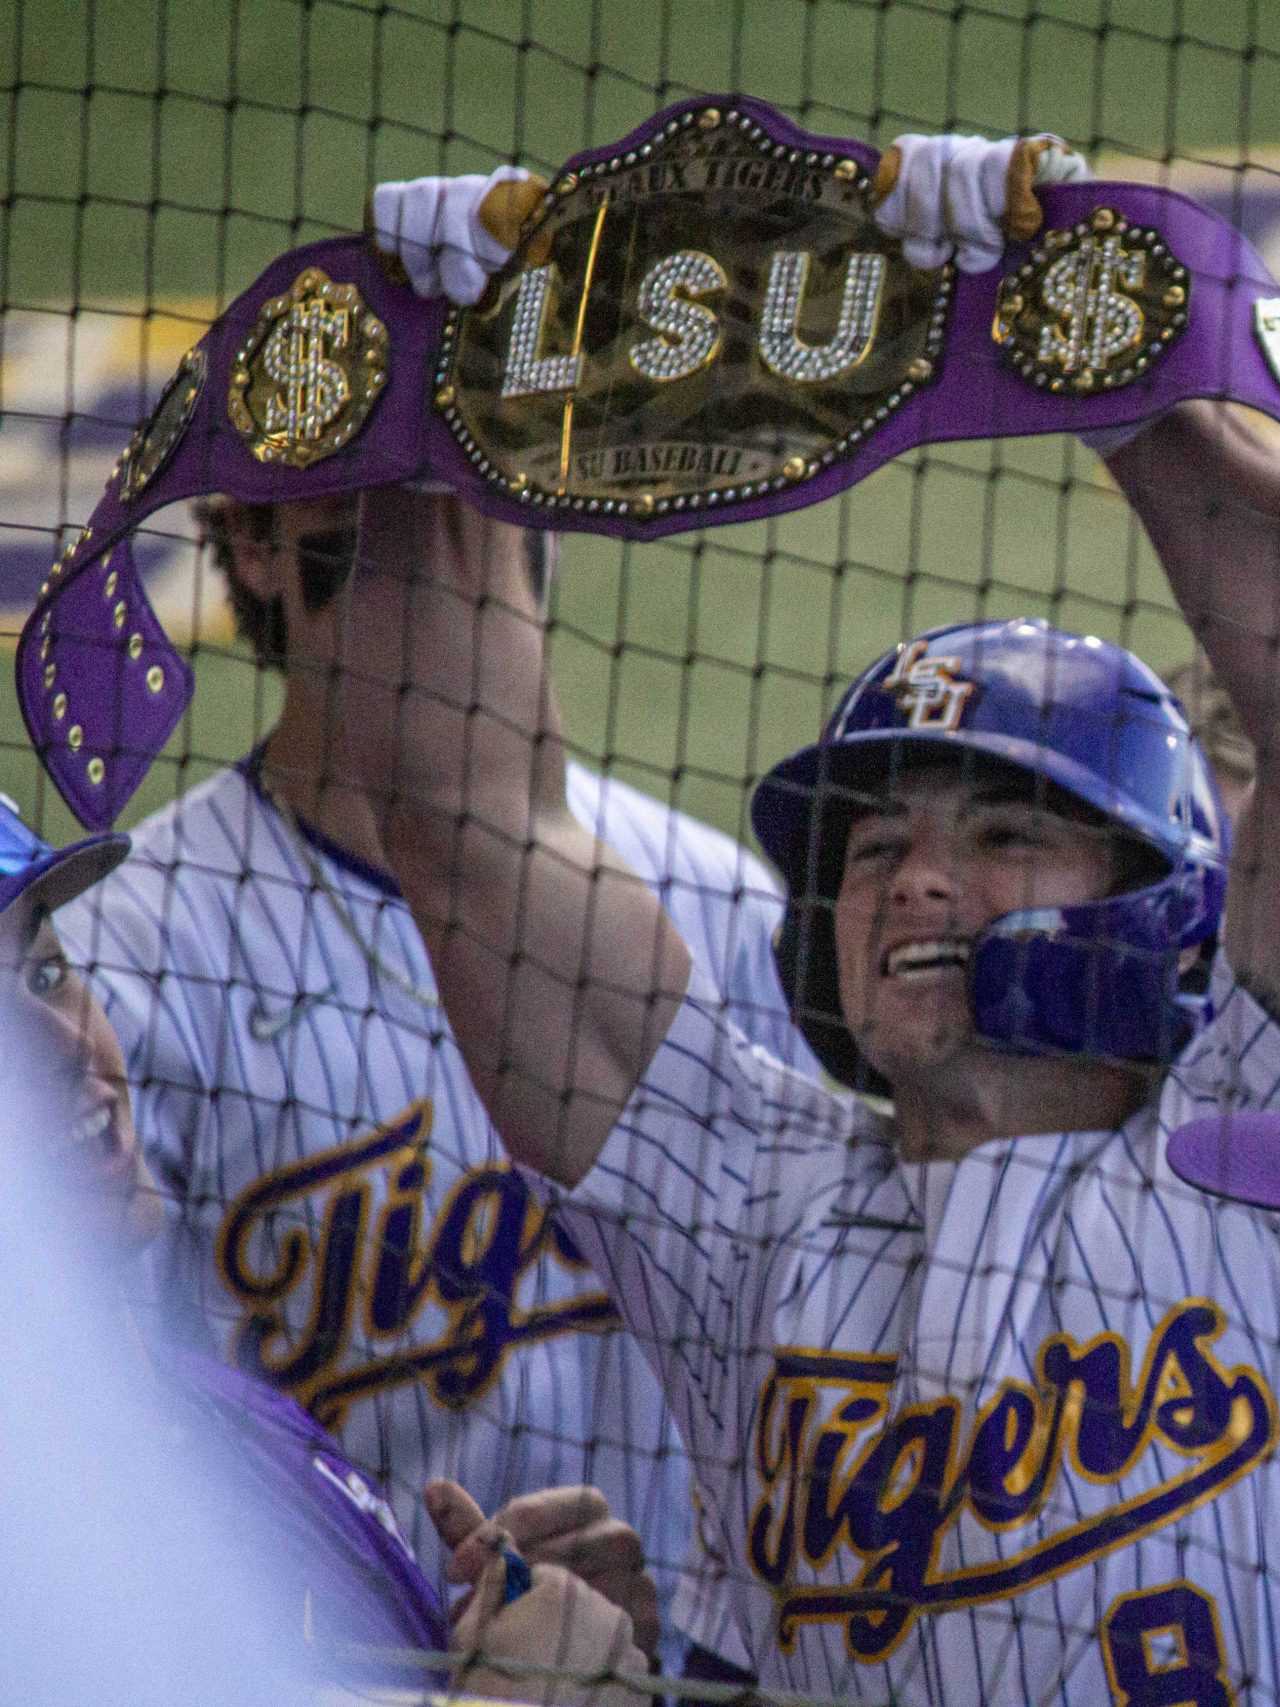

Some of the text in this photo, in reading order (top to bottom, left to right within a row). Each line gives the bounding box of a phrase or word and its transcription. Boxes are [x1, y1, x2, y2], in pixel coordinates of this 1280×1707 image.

[586, 160, 824, 201] AUX TIGERS
[501, 249, 887, 399] LSU
[612, 446, 743, 477] BASEBALL
[882, 640, 974, 730] LSU
[748, 1295, 1280, 1664] Tigers
[1098, 1577, 1240, 1707] 8
